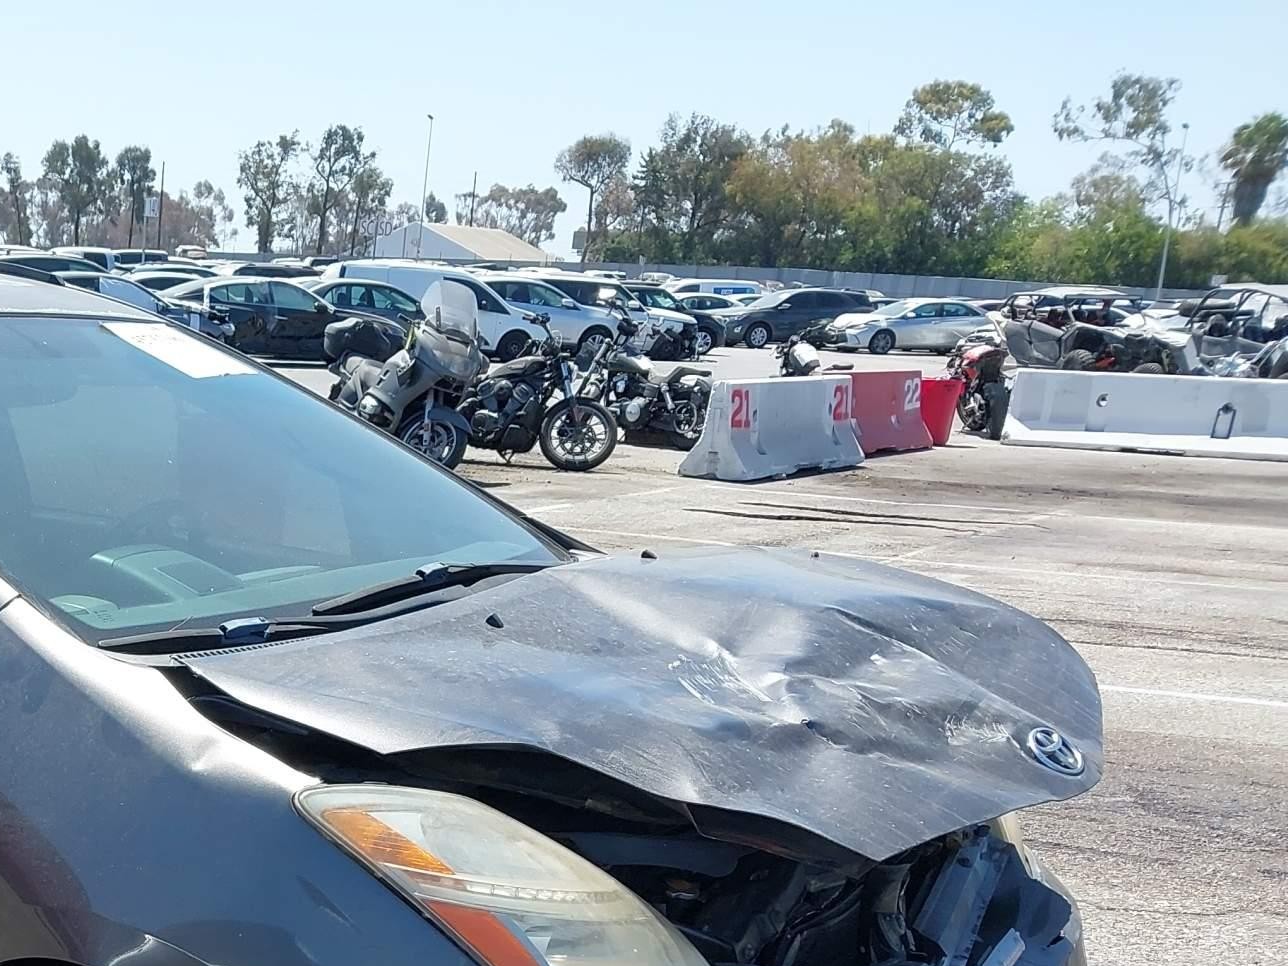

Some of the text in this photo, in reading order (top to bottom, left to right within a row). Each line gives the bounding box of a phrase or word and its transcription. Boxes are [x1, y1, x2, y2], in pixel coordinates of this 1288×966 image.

[730, 389, 750, 428] 21
[833, 385, 849, 421] 21
[904, 378, 921, 411] 22
